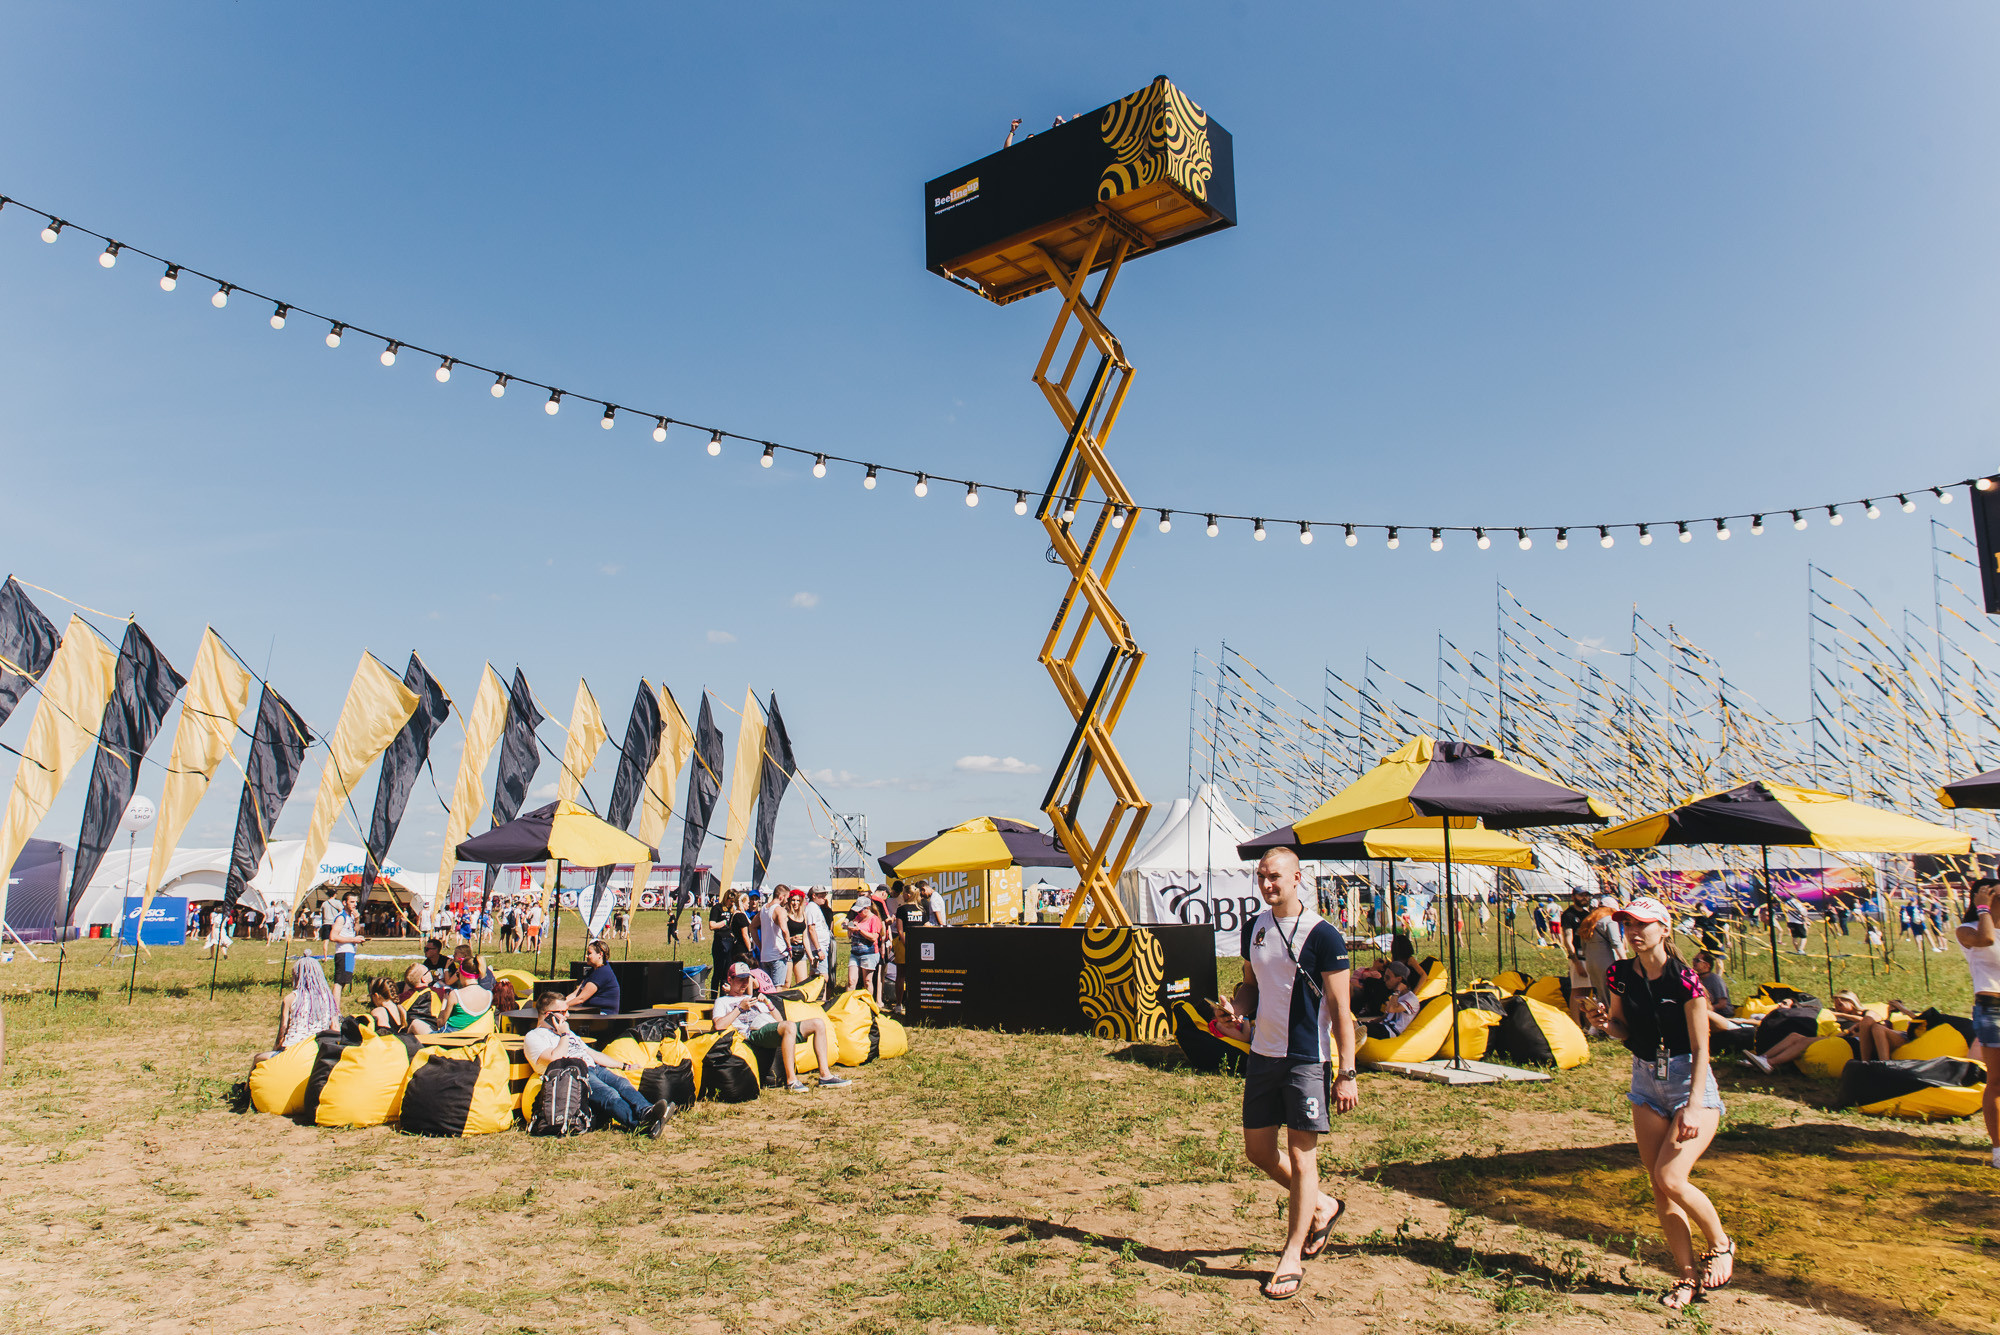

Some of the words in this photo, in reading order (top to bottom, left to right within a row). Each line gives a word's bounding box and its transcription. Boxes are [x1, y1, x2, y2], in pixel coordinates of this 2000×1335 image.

[935, 181, 979, 207] Beelineup
[320, 863, 365, 873] ShowCas
[380, 866, 401, 876] tage
[328, 876, 342, 886] by
[144, 909, 166, 917] SICS
[1306, 1097, 1319, 1119] 3
